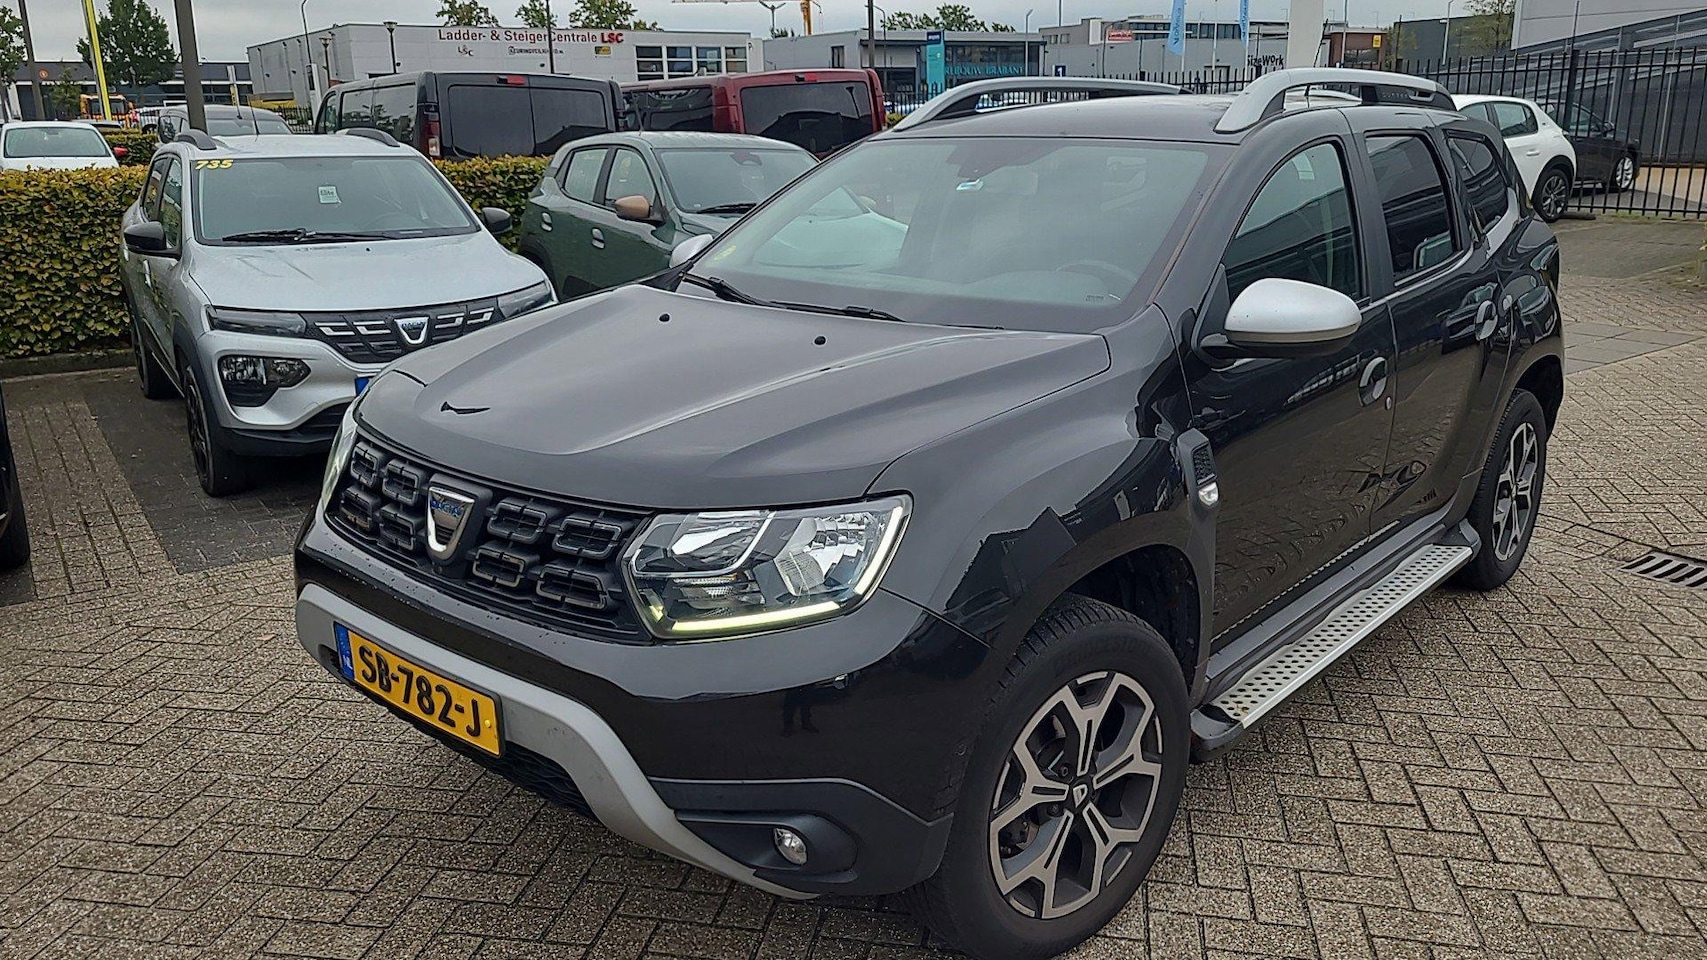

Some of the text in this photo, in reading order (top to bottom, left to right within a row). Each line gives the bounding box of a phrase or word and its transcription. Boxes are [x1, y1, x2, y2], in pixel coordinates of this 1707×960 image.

[438, 29, 486, 41] Ladder-
[490, 30, 500, 41] &
[601, 33, 624, 43] LSC
[194, 160, 234, 170] 735
[358, 645, 481, 737] SB-782-J
